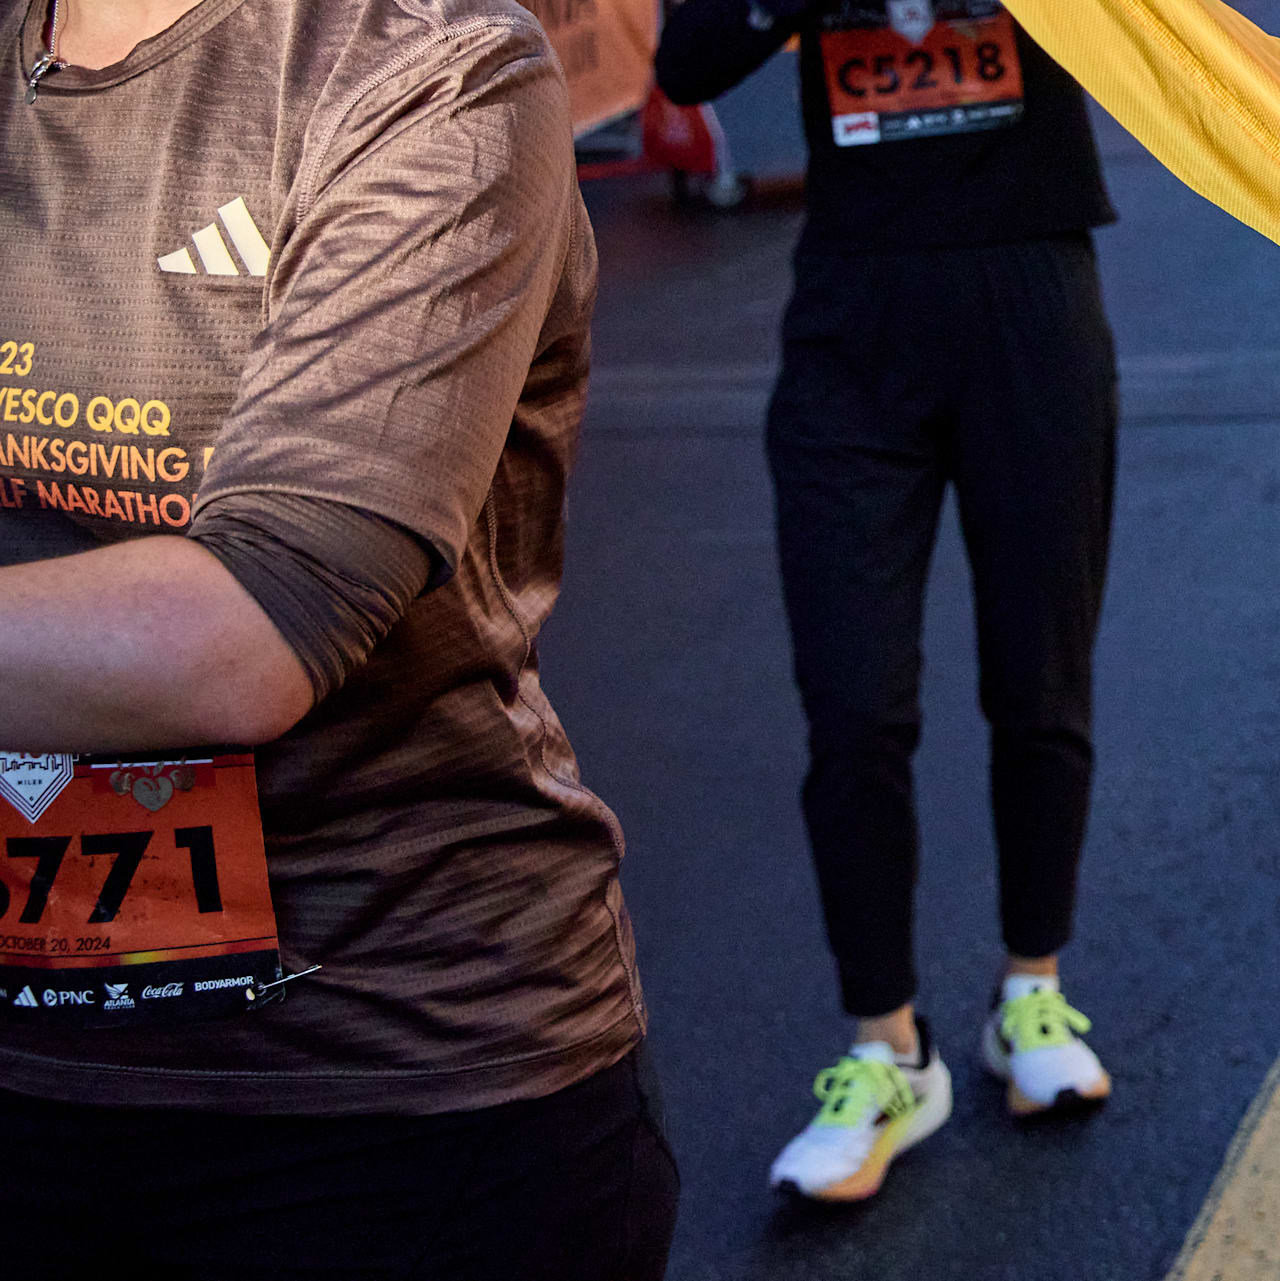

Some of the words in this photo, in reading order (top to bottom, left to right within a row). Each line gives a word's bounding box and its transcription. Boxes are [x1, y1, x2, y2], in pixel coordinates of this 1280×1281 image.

[838, 42, 1005, 98] C5218
[86, 395, 171, 437] QQQ
[36, 479, 198, 528] MARATHO
[0, 825, 223, 924] 771
[50, 938, 72, 953] 20,
[76, 936, 111, 951] 2024
[59, 990, 95, 1006] PNC
[194, 975, 254, 992] BODYARMOR
[103, 998, 135, 1007] ATLANTA
